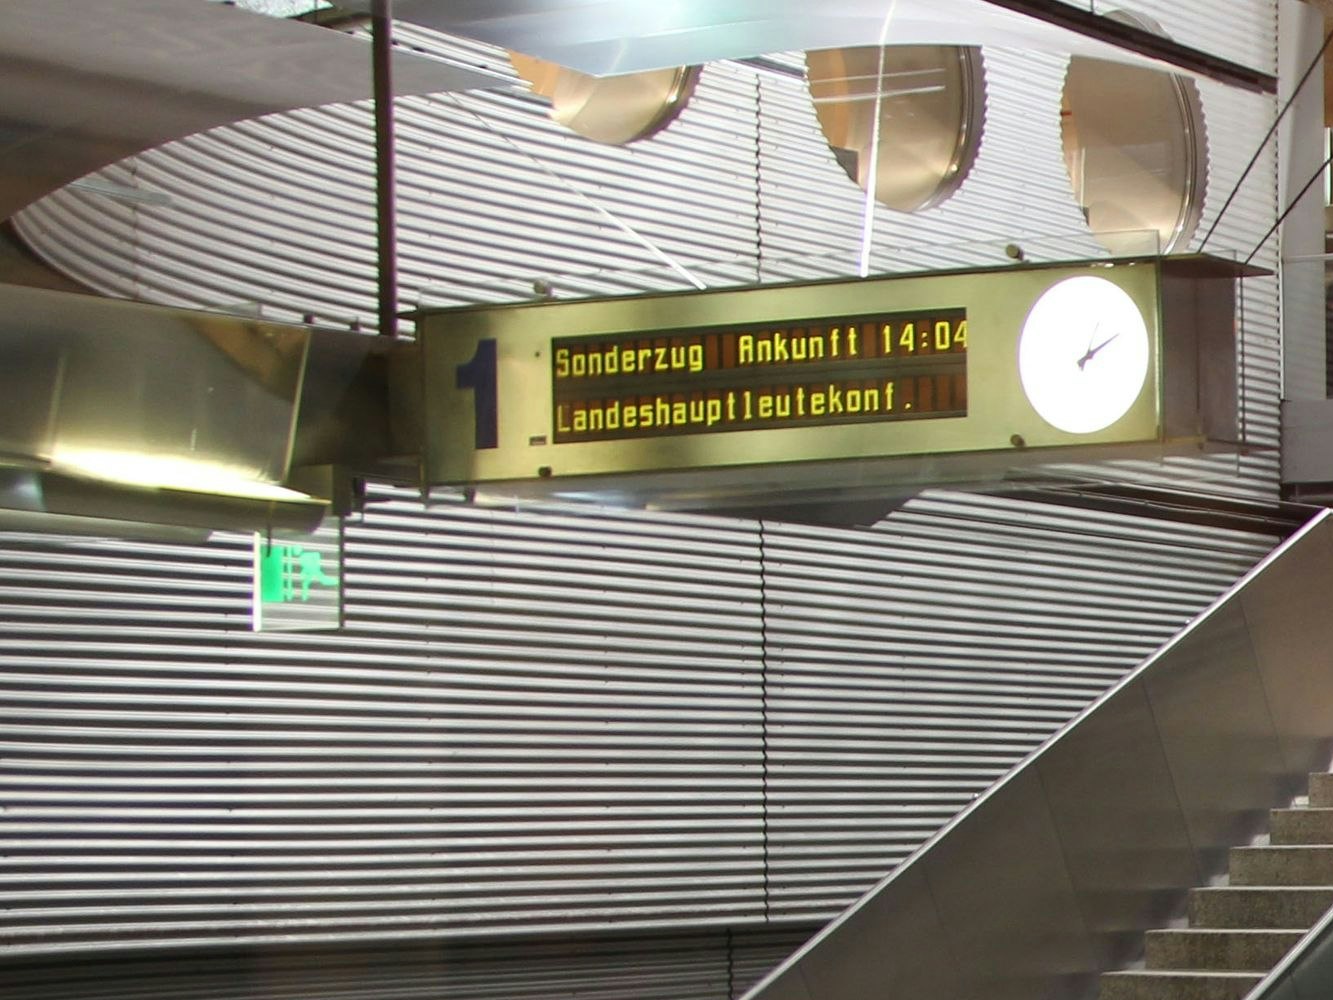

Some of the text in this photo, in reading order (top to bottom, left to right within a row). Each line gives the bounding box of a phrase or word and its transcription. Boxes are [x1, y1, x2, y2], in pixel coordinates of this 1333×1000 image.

[556, 320, 968, 377] Sonderzug Ankunft 14:04
[456, 338, 498, 449] 1
[557, 382, 912, 432] Landeshauptleutekonf.
